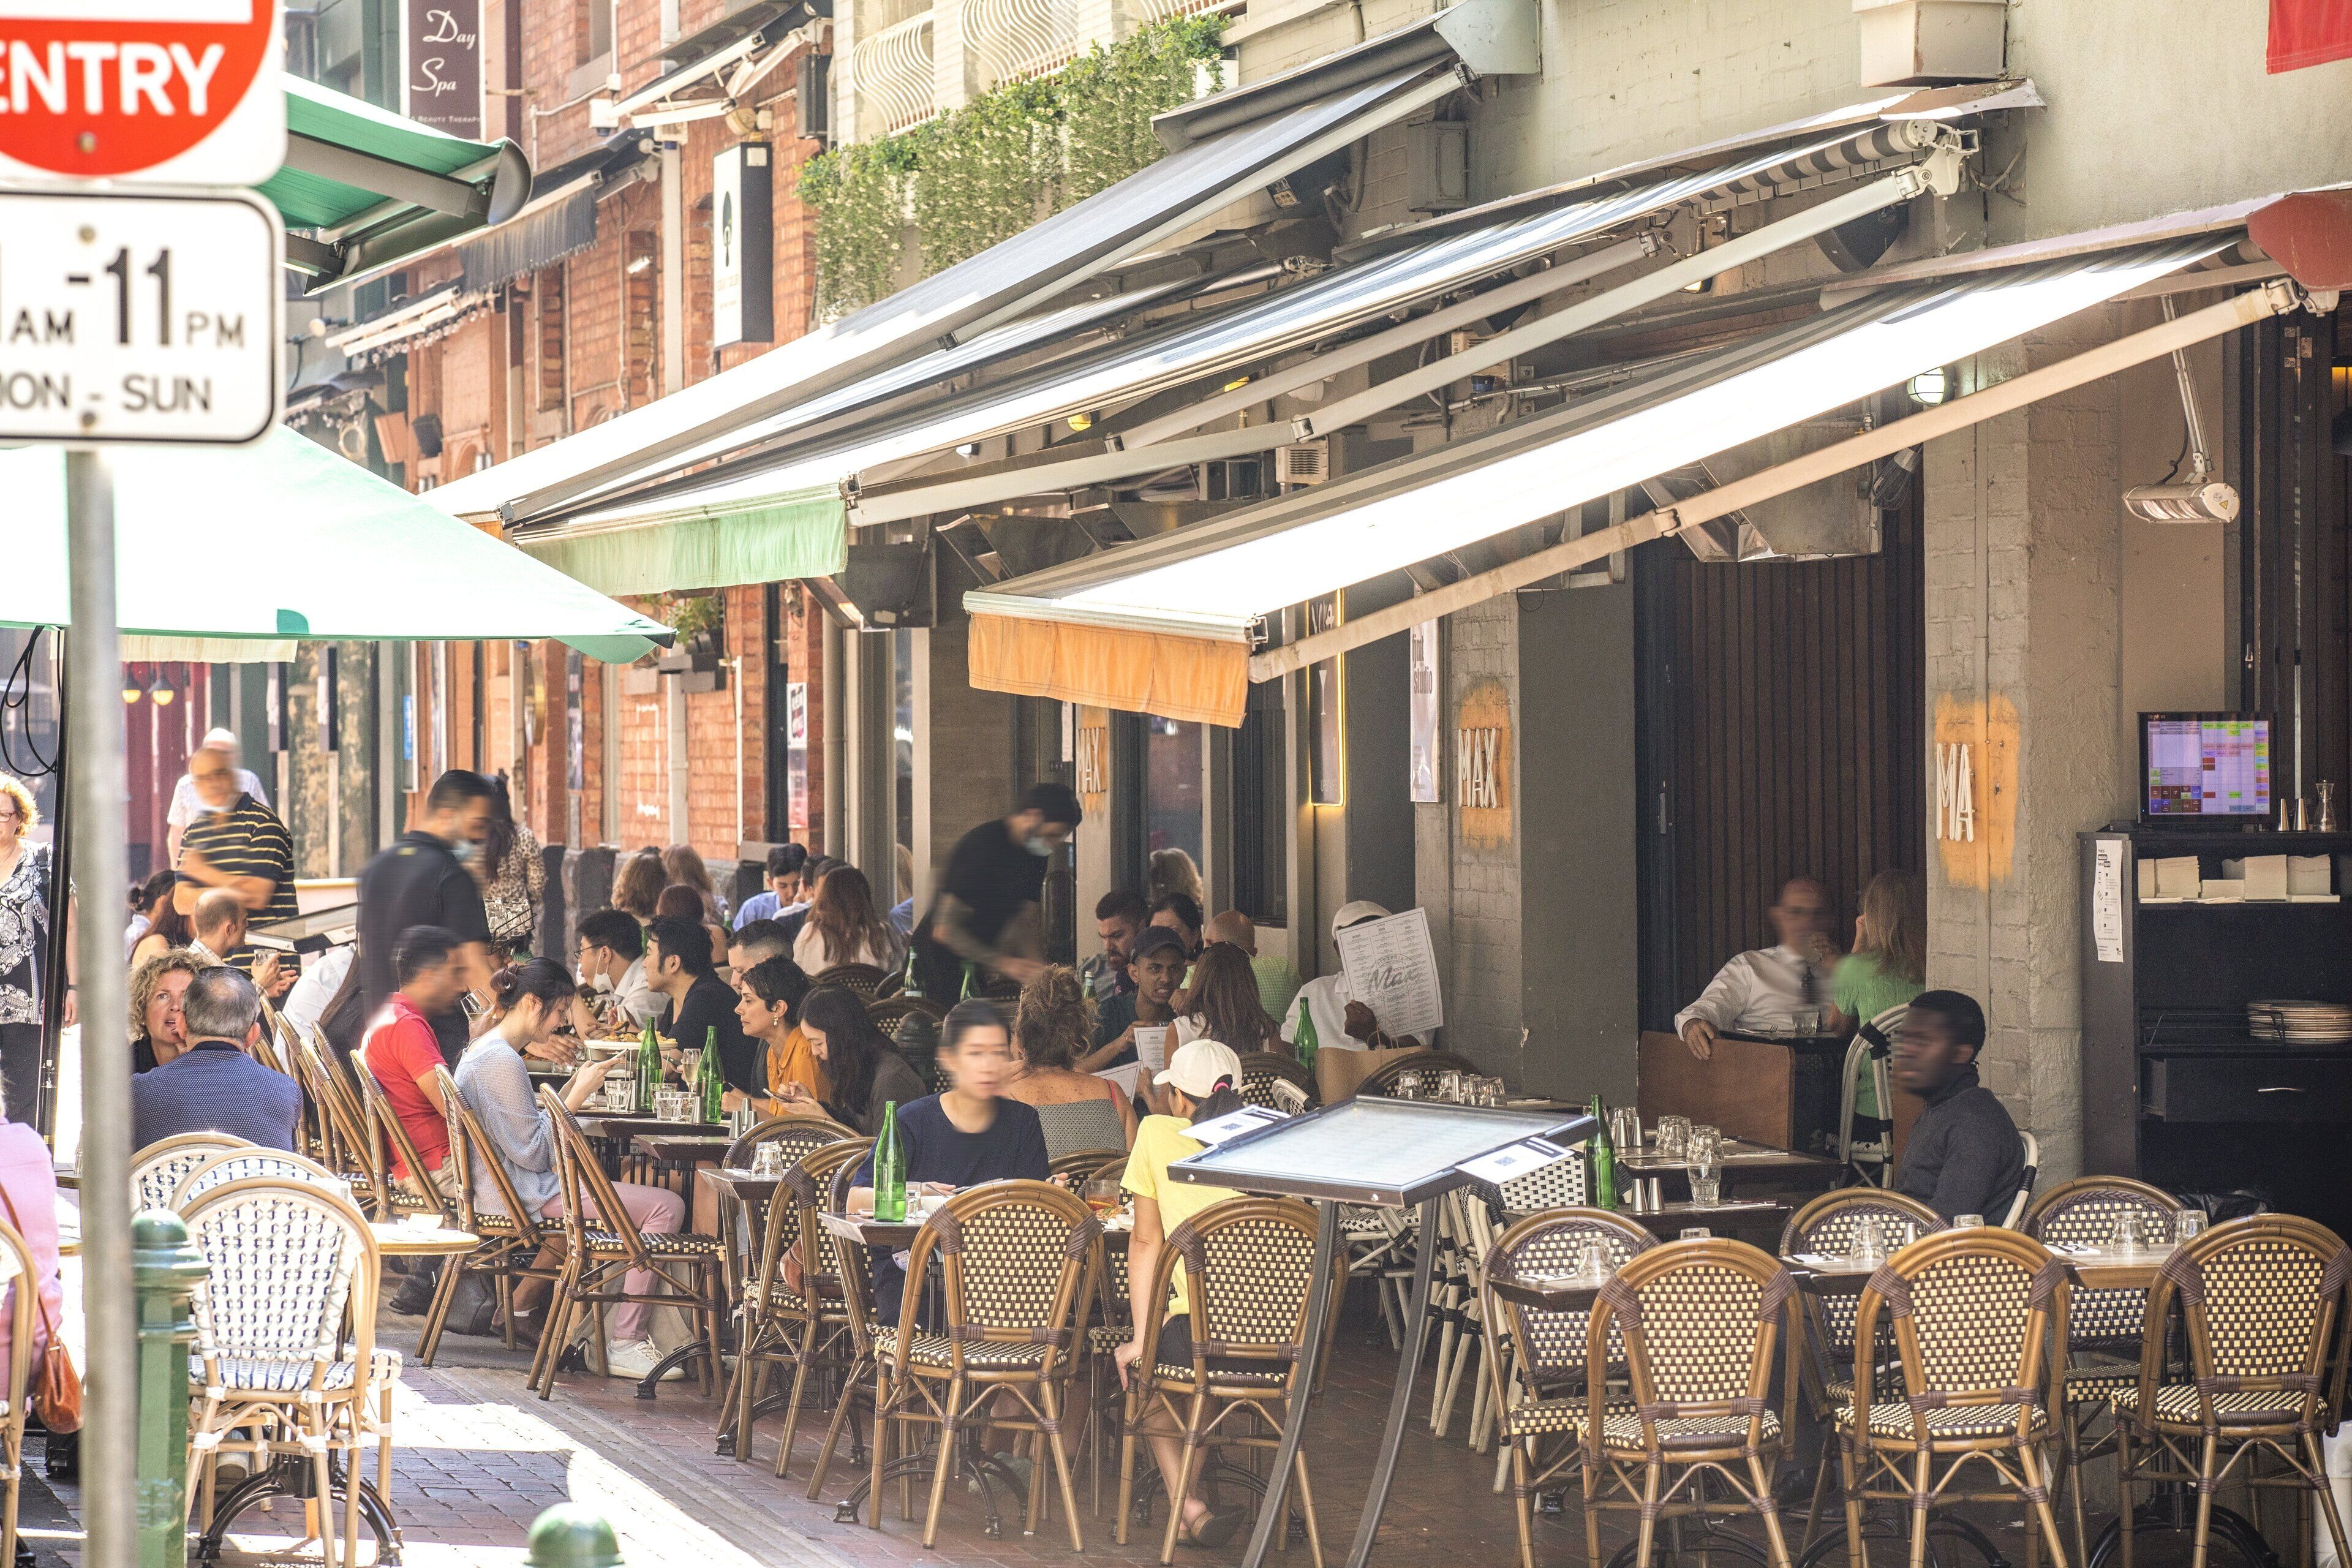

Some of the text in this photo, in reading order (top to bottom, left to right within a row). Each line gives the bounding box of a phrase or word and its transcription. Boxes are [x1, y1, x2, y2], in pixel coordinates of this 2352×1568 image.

[423, 9, 476, 50] Day
[0, 39, 226, 117] NTRY
[411, 57, 456, 97] Spa
[186, 310, 244, 349] PM
[0, 371, 71, 410] ON
[121, 372, 212, 413] SUN
[1414, 666, 1433, 694] studio
[1076, 727, 1101, 793] MAX
[1458, 728, 1498, 809] MAX
[1936, 742, 1974, 843] MA
[1368, 964, 1421, 995] Max
